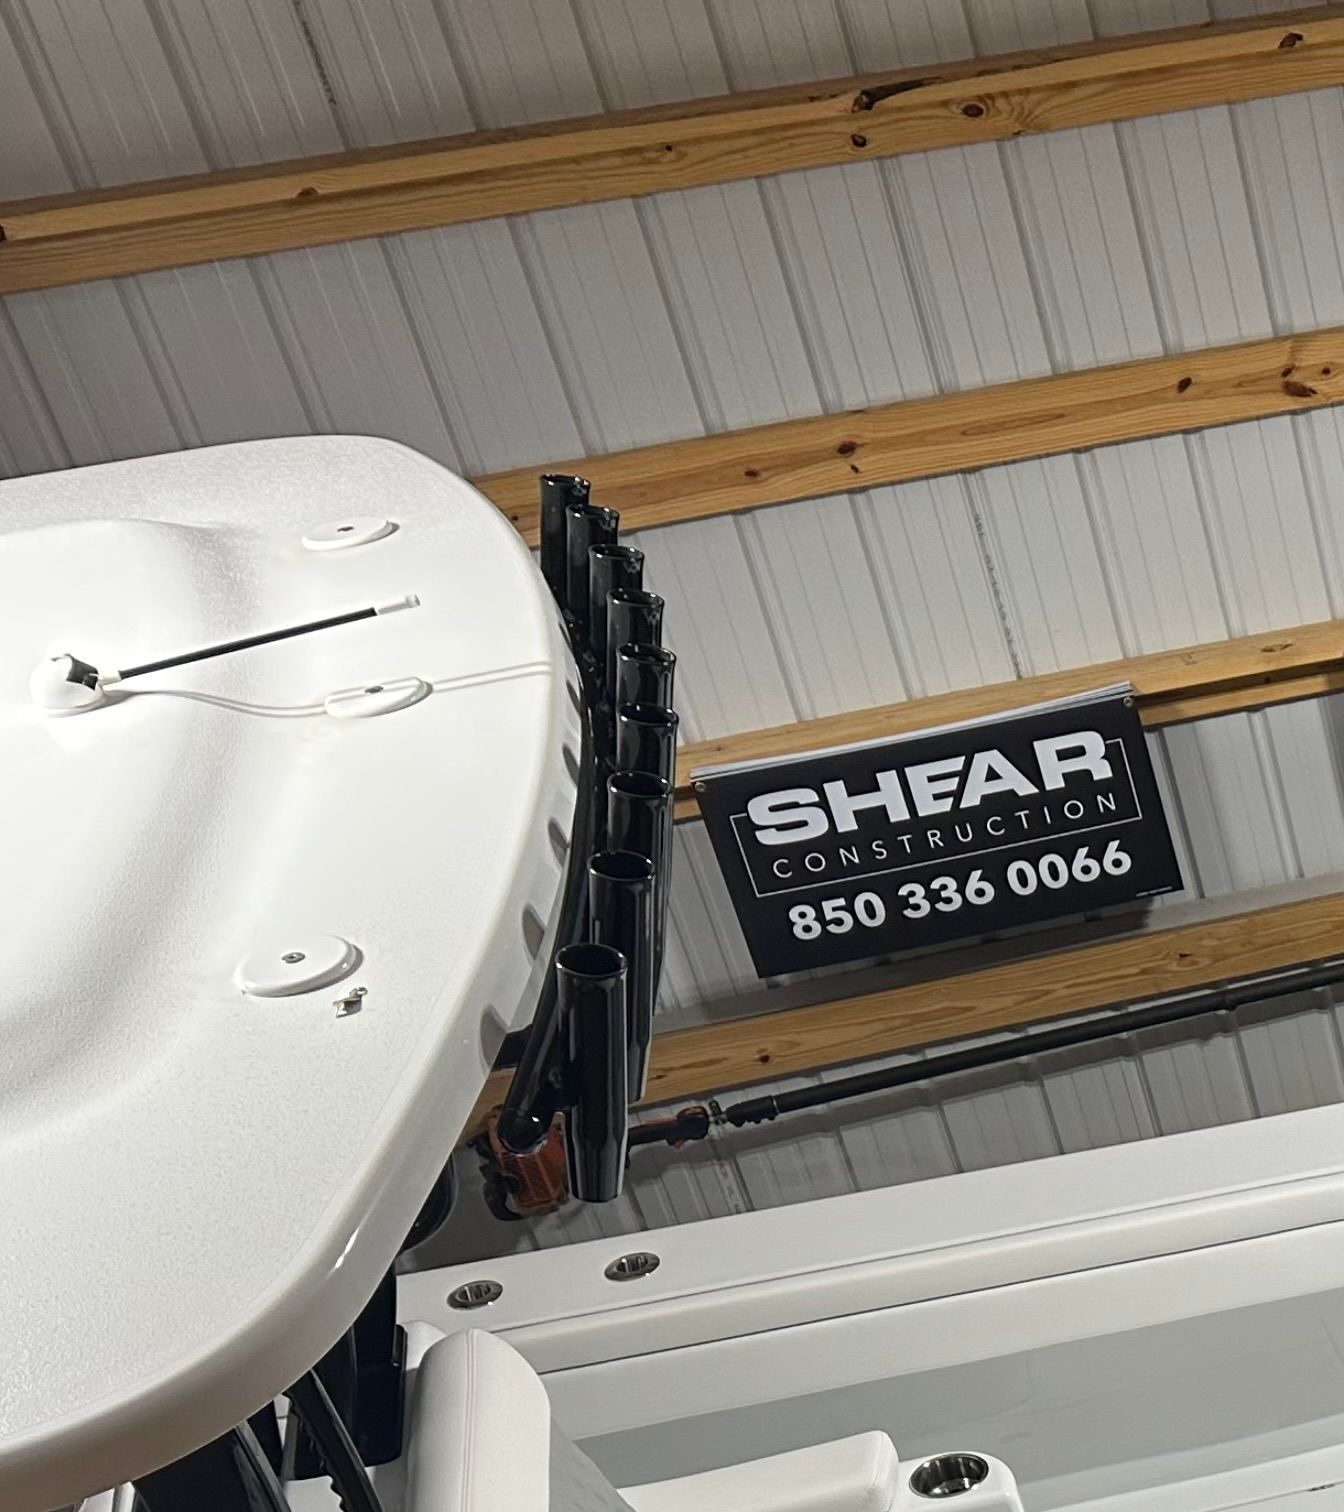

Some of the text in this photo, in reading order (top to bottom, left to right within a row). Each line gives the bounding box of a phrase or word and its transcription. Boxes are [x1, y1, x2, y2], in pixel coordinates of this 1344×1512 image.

[747, 730, 1113, 846] SHEAR
[773, 793, 1117, 879] CONSTRUCTION
[788, 839, 1132, 940] 850 336 0066
